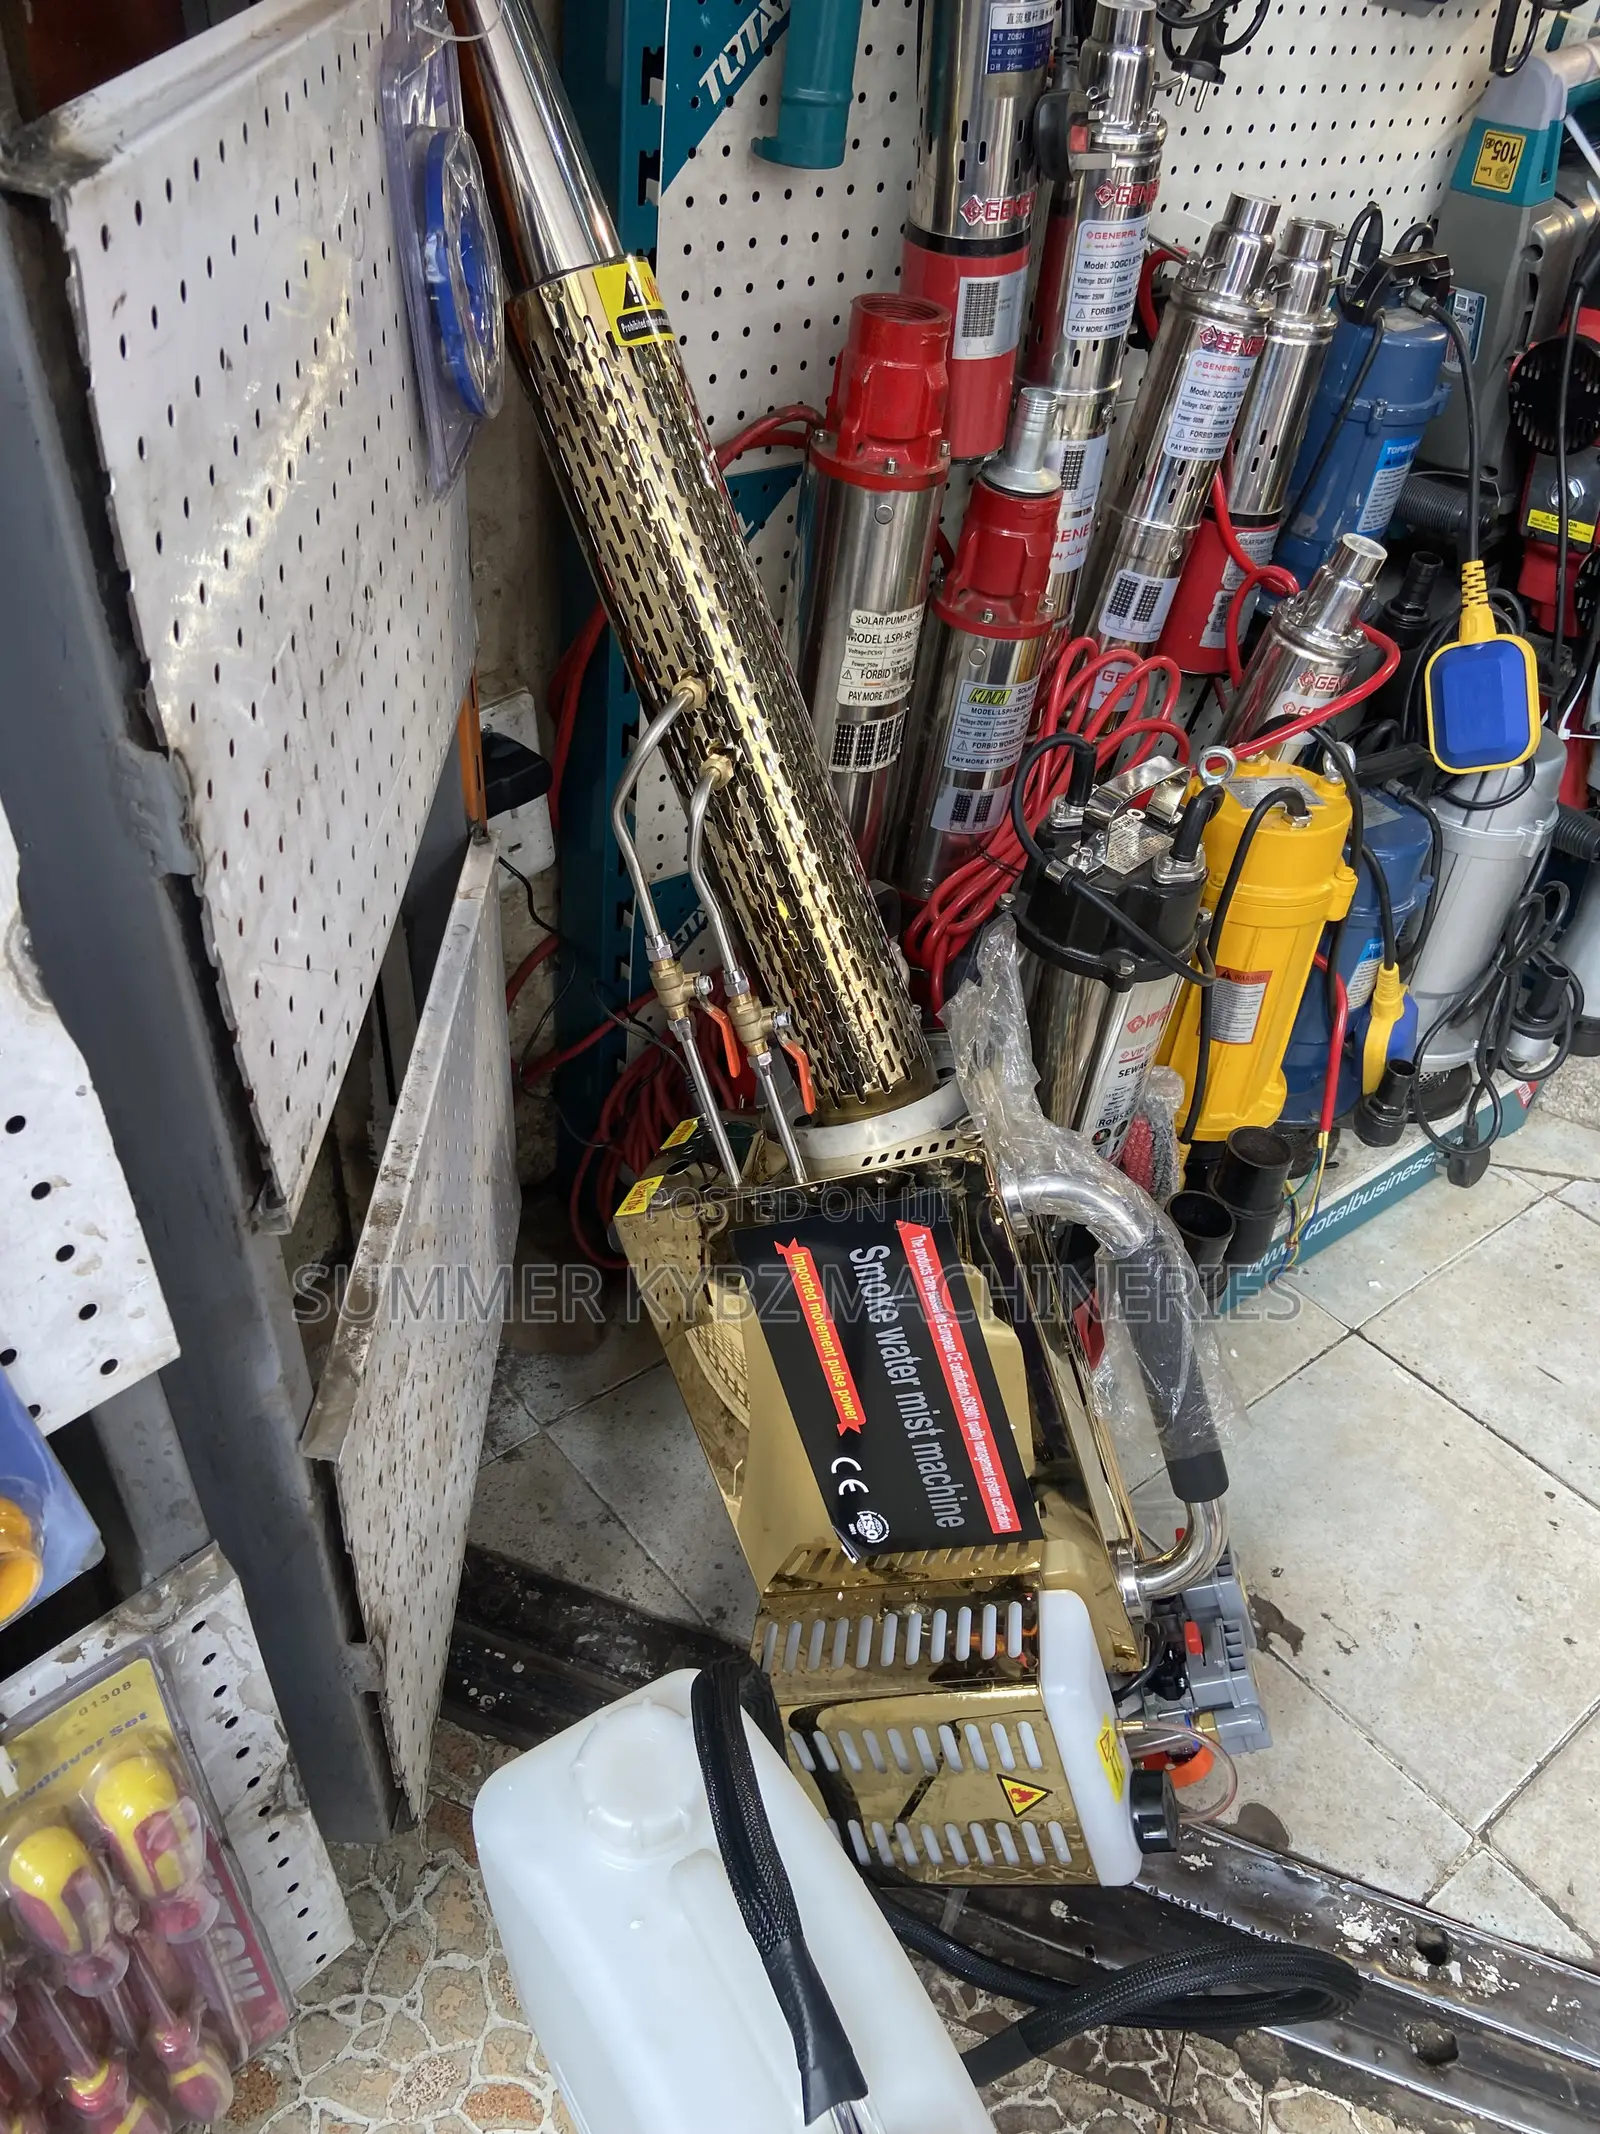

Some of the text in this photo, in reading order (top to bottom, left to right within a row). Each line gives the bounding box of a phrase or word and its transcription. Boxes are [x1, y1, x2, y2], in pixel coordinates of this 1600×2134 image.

[698, 0, 790, 104] TOTA
[1094, 229, 1137, 240] GENERAL
[1090, 305, 1116, 316] FORBID
[1071, 324, 1085, 333] PAY
[1085, 323, 1103, 333] MORE
[1189, 429, 1213, 439] FORBID
[1170, 442, 1182, 452] PAY
[1183, 445, 1199, 454] MORE
[860, 669, 891, 680] FORBID
[848, 690, 862, 701] PAY
[862, 691, 883, 701] MORE
[971, 741, 998, 750] FORBID
[965, 757, 984, 765] MORE
[791, 1251, 859, 1421] Imported movement pulse power
[936, 1322, 957, 1352] European
[849, 1245, 968, 1528] Smoke water mist machine
[964, 1418, 986, 1442] quality
[973, 1440, 998, 1478] management
[981, 1475, 1001, 1498] system
[991, 1496, 1011, 1531] certification
[78, 1681, 132, 1716] 01308
